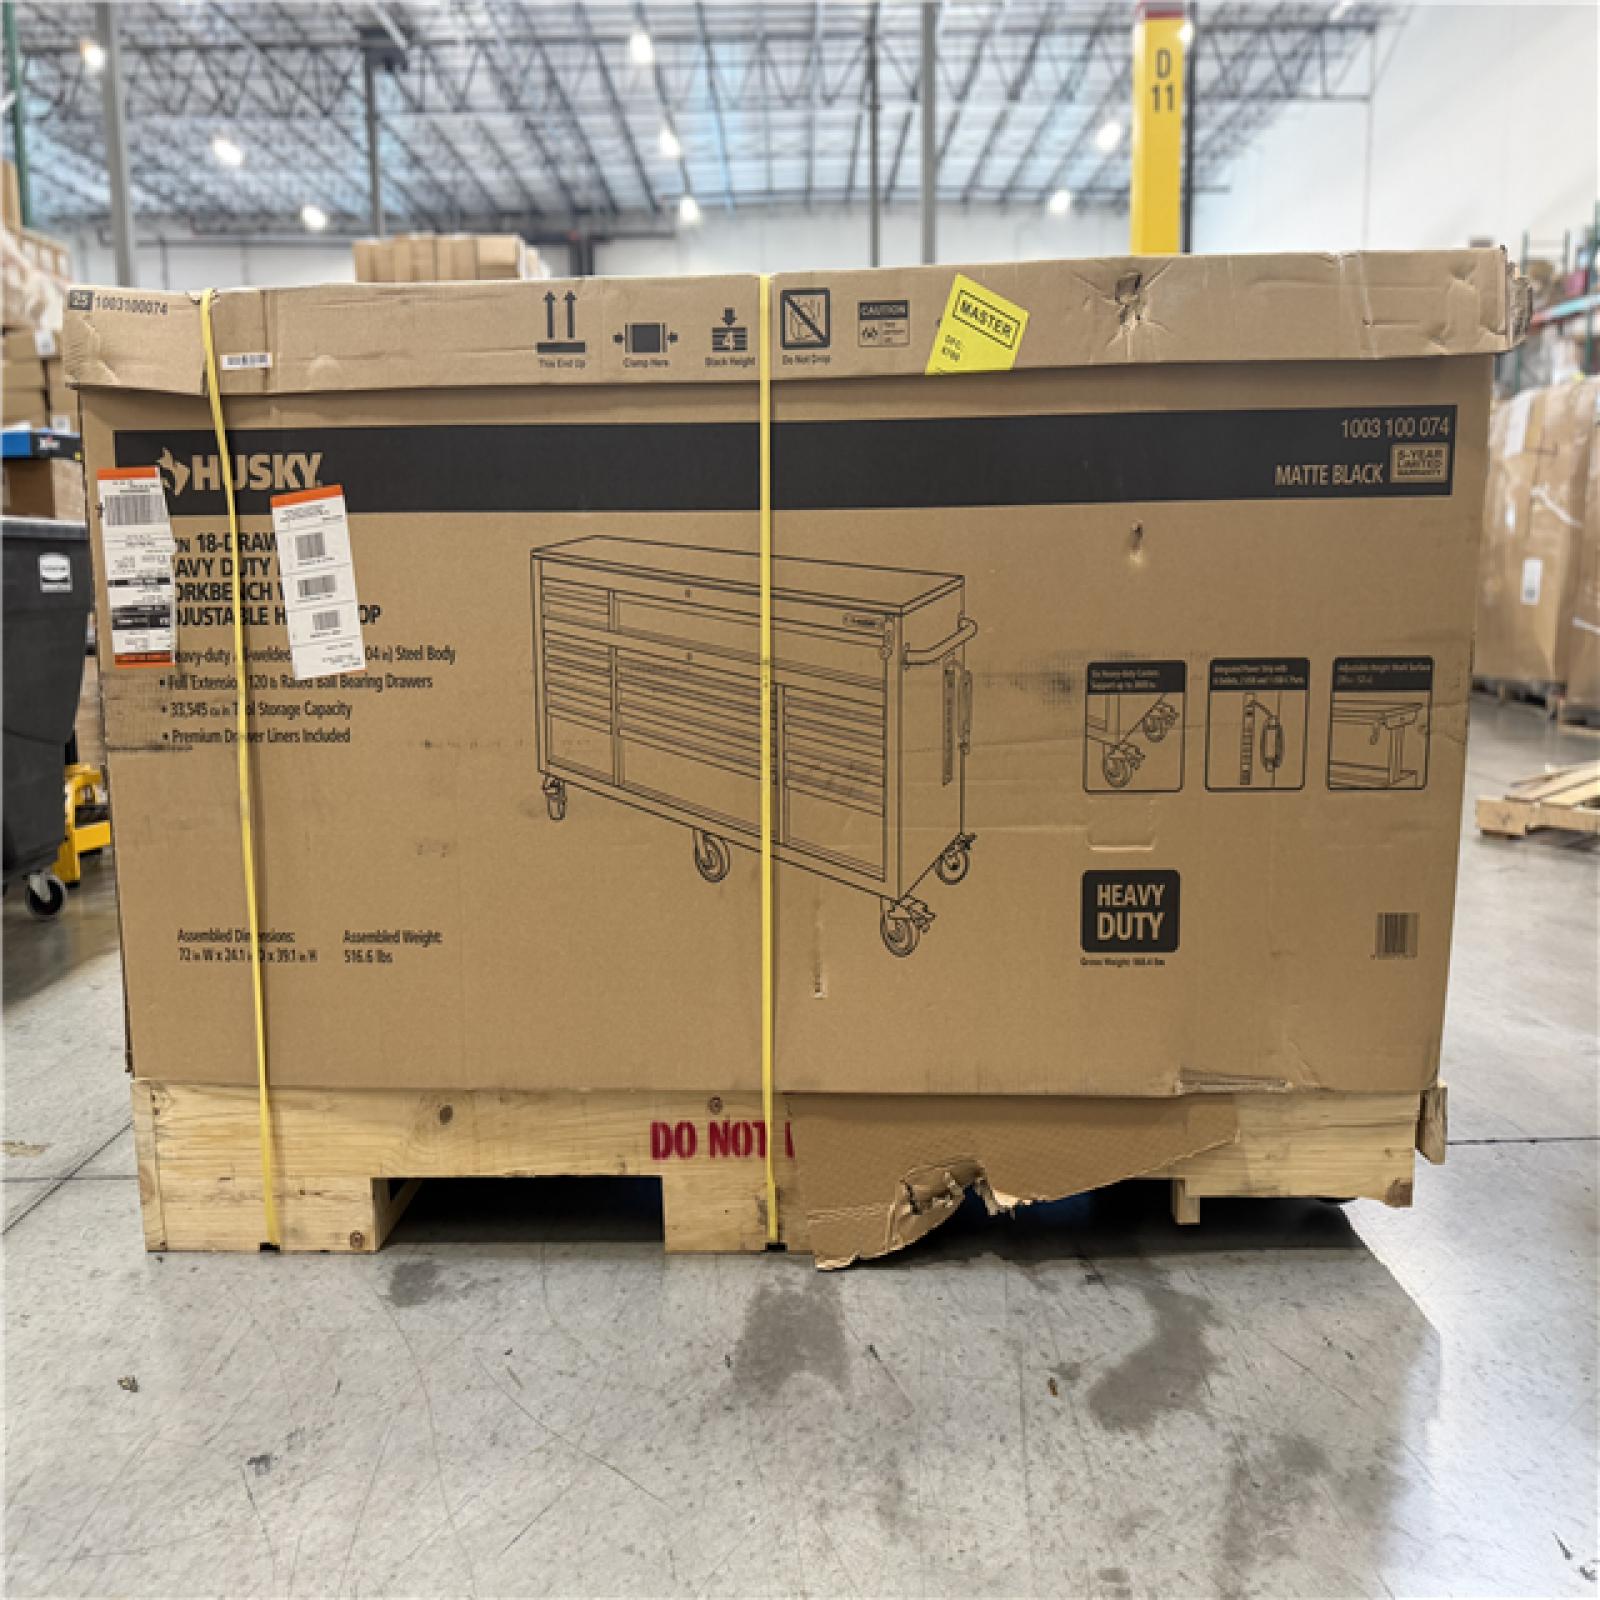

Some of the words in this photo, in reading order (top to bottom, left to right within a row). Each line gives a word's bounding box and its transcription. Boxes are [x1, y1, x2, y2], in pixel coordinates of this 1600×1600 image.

[1152, 83, 1175, 112] 11
[96, 296, 169, 315] 1003100074
[960, 299, 1014, 339] MASTER
[1342, 418, 1381, 438] 1003
[1385, 417, 1416, 437] 100
[1419, 416, 1449, 436] 074
[191, 454, 322, 491] HUSKY
[1274, 464, 1329, 486] MATTE
[1331, 462, 1384, 484] BLACK
[175, 557, 214, 577] AVY
[359, 604, 381, 625] OP
[395, 645, 423, 661] Steel
[427, 645, 455, 665] Body
[190, 674, 238, 690] Extensio
[340, 673, 383, 692] Bearing
[385, 673, 433, 689] Drawers
[170, 702, 208, 717] 33,545
[233, 702, 255, 716] Tol
[259, 702, 301, 720] Storage
[304, 700, 352, 720] Capacity
[172, 729, 221, 743] Premium
[225, 729, 264, 743] Drwer
[267, 728, 301, 743] Liners
[303, 727, 351, 743] Included
[1097, 884, 1165, 906] HEAVY
[177, 928, 232, 943] Assembled
[1097, 912, 1165, 941] DUTY
[343, 930, 400, 945] Assembled
[403, 931, 443, 947] Weight:
[651, 1121, 698, 1160] DO
[708, 1121, 767, 1159] NOT
